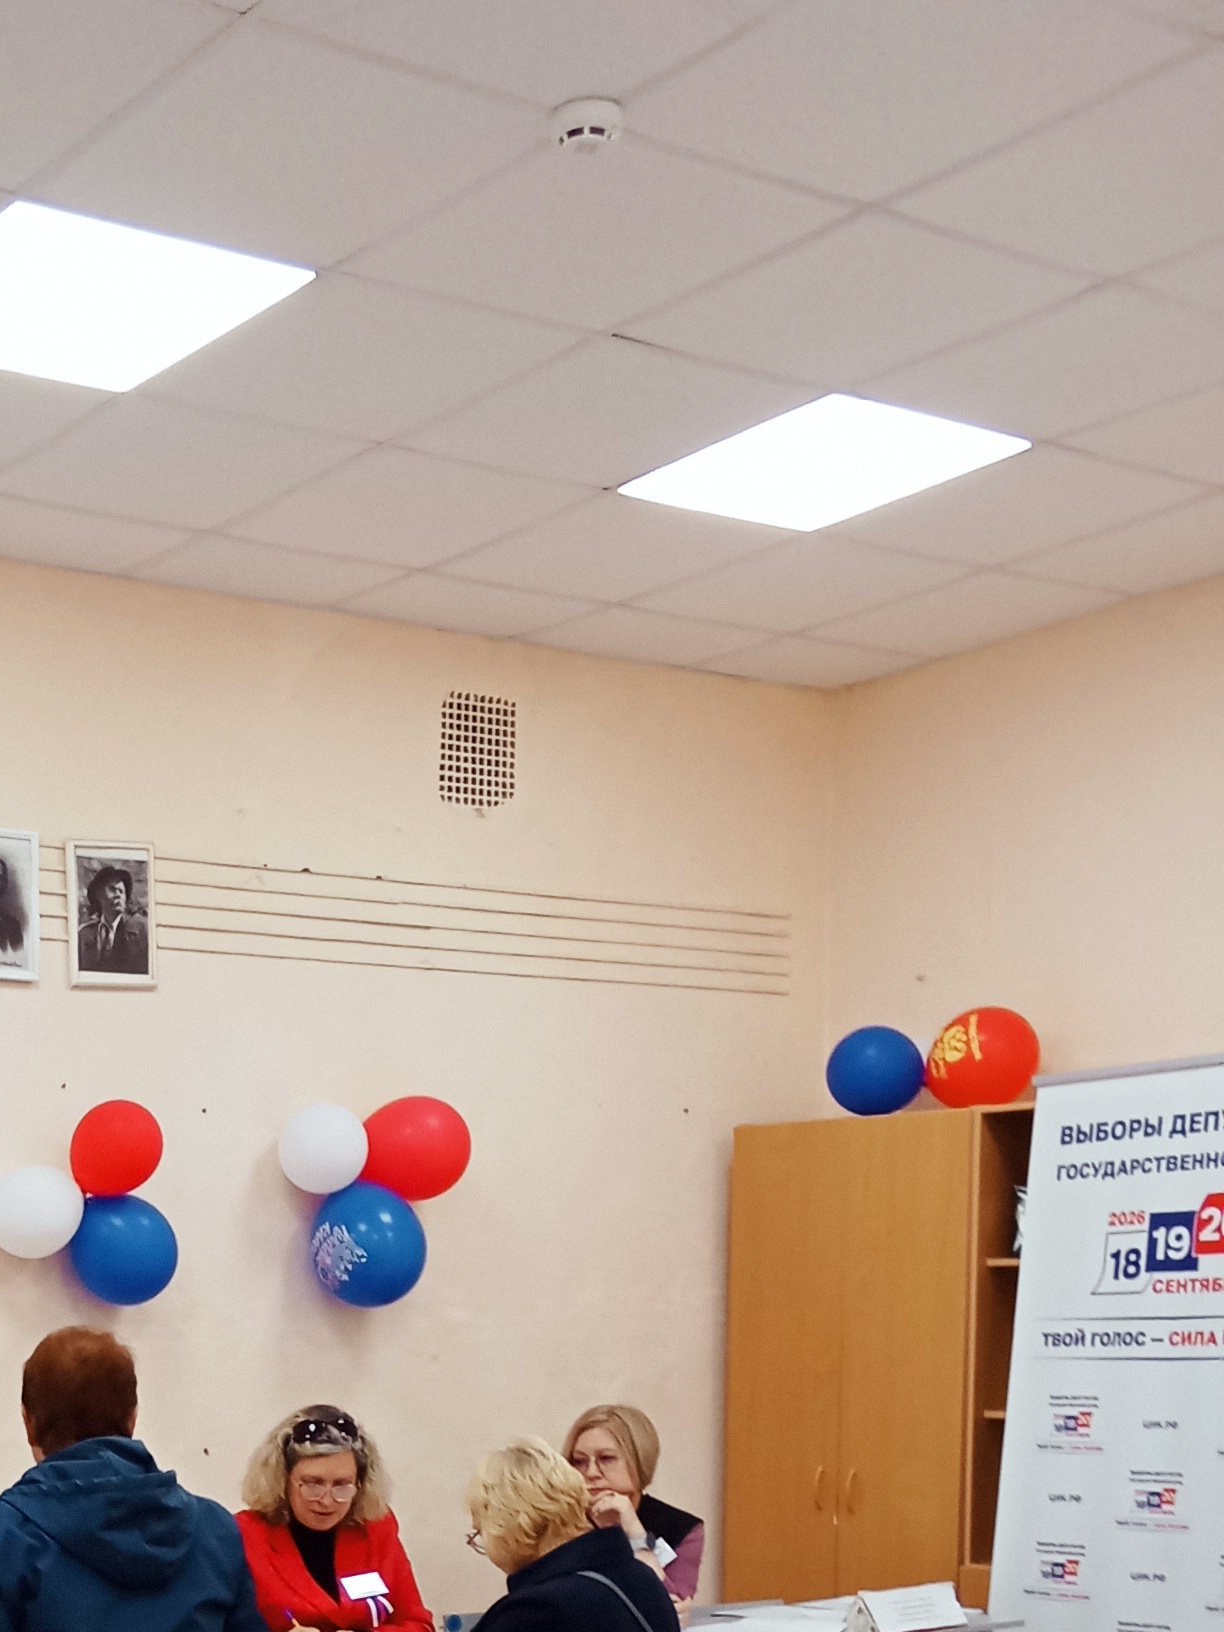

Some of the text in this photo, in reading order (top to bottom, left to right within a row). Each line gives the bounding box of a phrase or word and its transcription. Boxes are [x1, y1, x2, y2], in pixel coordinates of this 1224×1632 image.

[1059, 1109, 1224, 1146] ВЫБОРЫ ДЕП
[1108, 1210, 1146, 1227] 2026
[1109, 1206, 1224, 1281] 18 19 2
[1152, 1277, 1224, 1294] СЕНТЯБ
[1042, 1328, 1086, 1347] ТВОЙ
[1090, 1331, 1147, 1347] ГОЛОС
[1168, 1331, 1218, 1348] СИЛА
